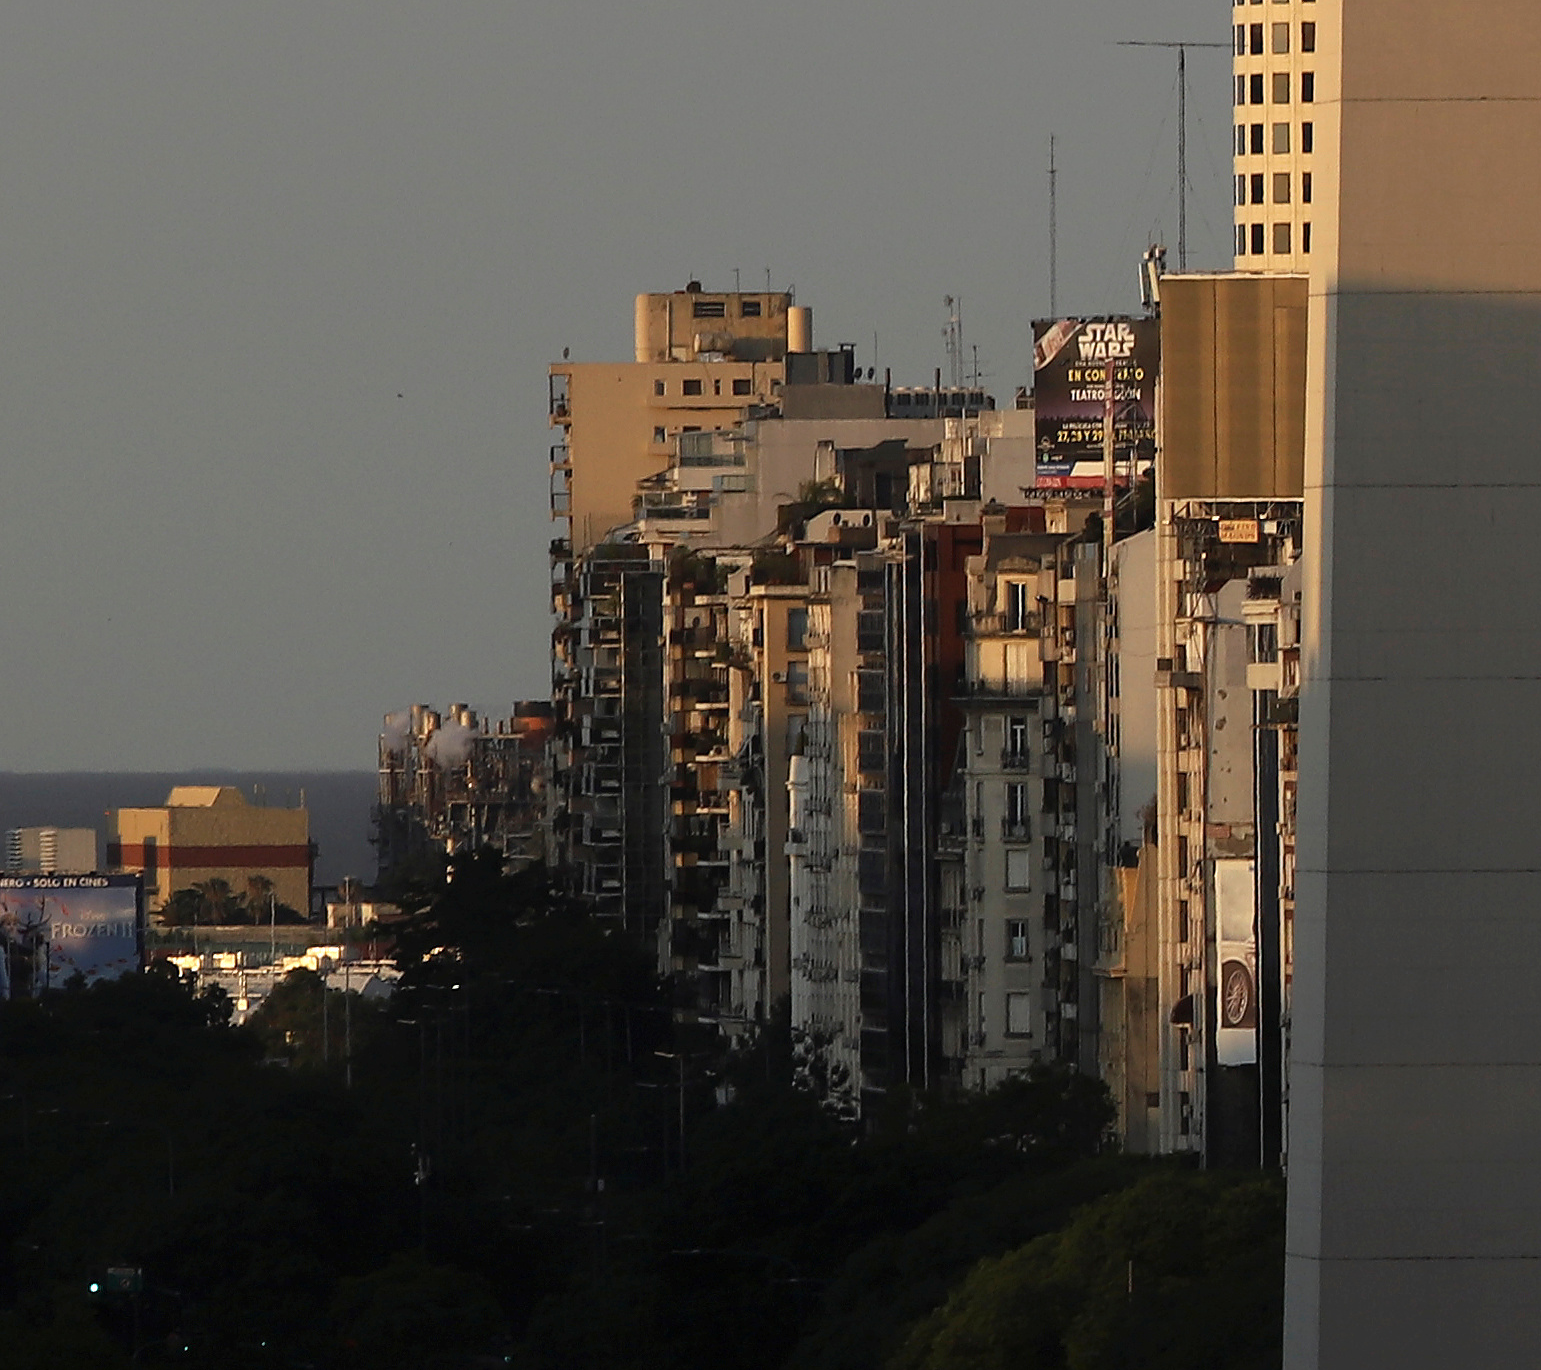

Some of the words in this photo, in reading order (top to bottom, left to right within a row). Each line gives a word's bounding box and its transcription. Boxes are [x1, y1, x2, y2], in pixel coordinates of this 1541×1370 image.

[1078, 322, 1135, 343] STAR
[1078, 341, 1135, 359] WARS
[51, 922, 119, 940] FROZEN
